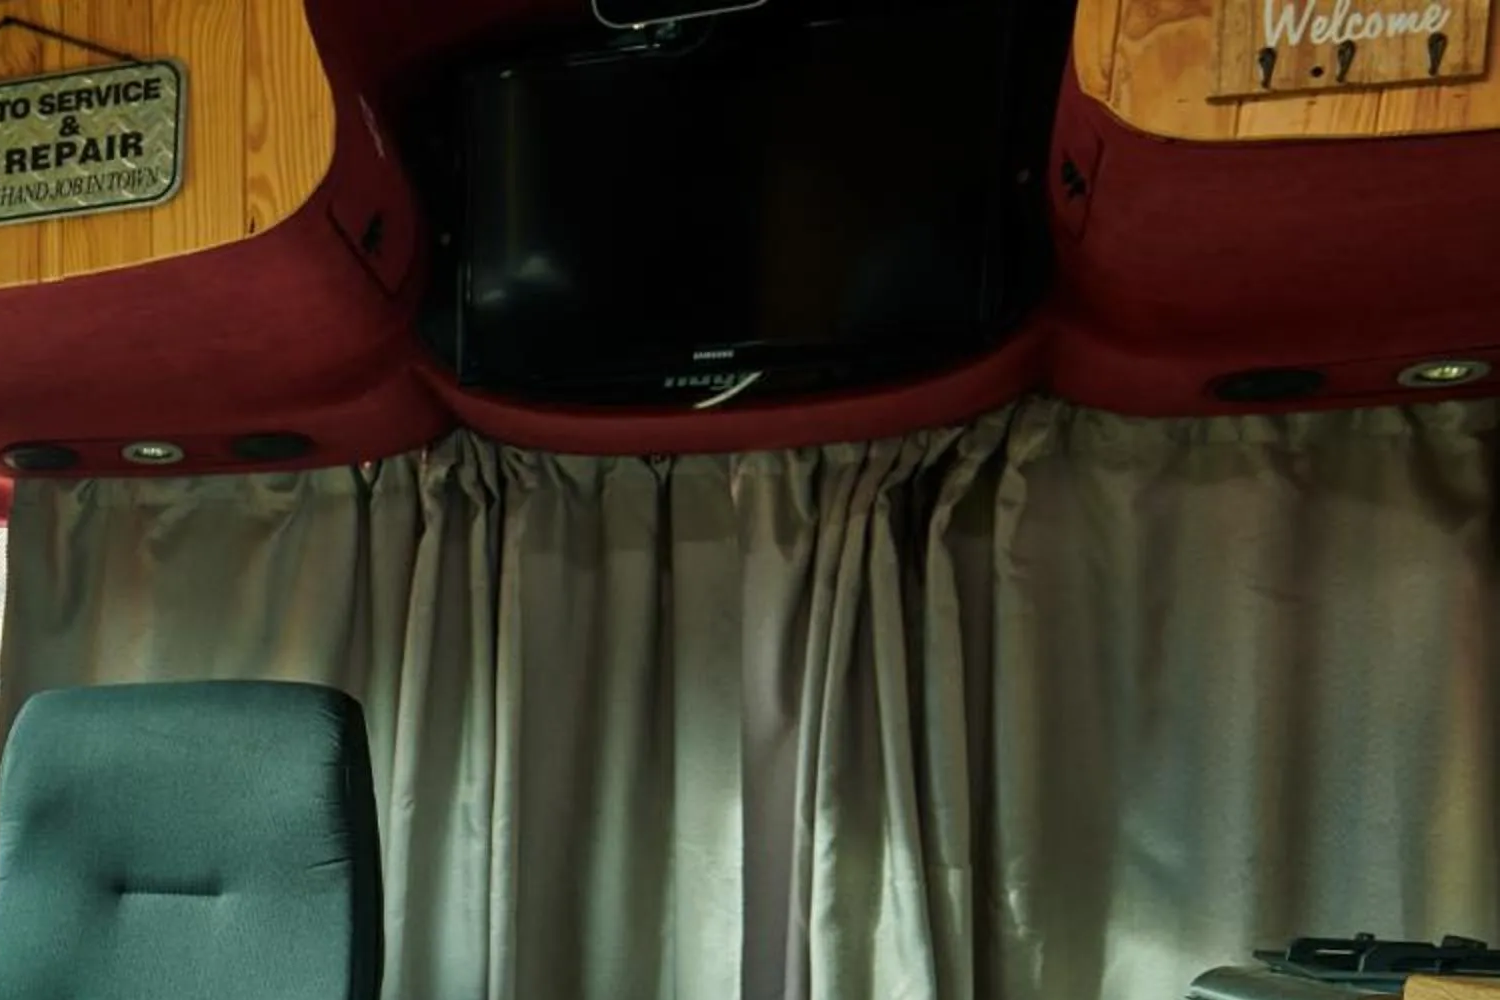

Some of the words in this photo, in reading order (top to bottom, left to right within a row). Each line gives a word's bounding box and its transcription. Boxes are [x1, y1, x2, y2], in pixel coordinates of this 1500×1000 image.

[1263, 0, 1451, 47] Welcome
[38, 77, 161, 115] SERVICE
[59, 115, 80, 137] &
[4, 131, 144, 175] REPAIR
[0, 183, 49, 206] HAND
[49, 178, 83, 202] JOB
[85, 173, 106, 194] IN
[107, 166, 161, 191] TOWN
